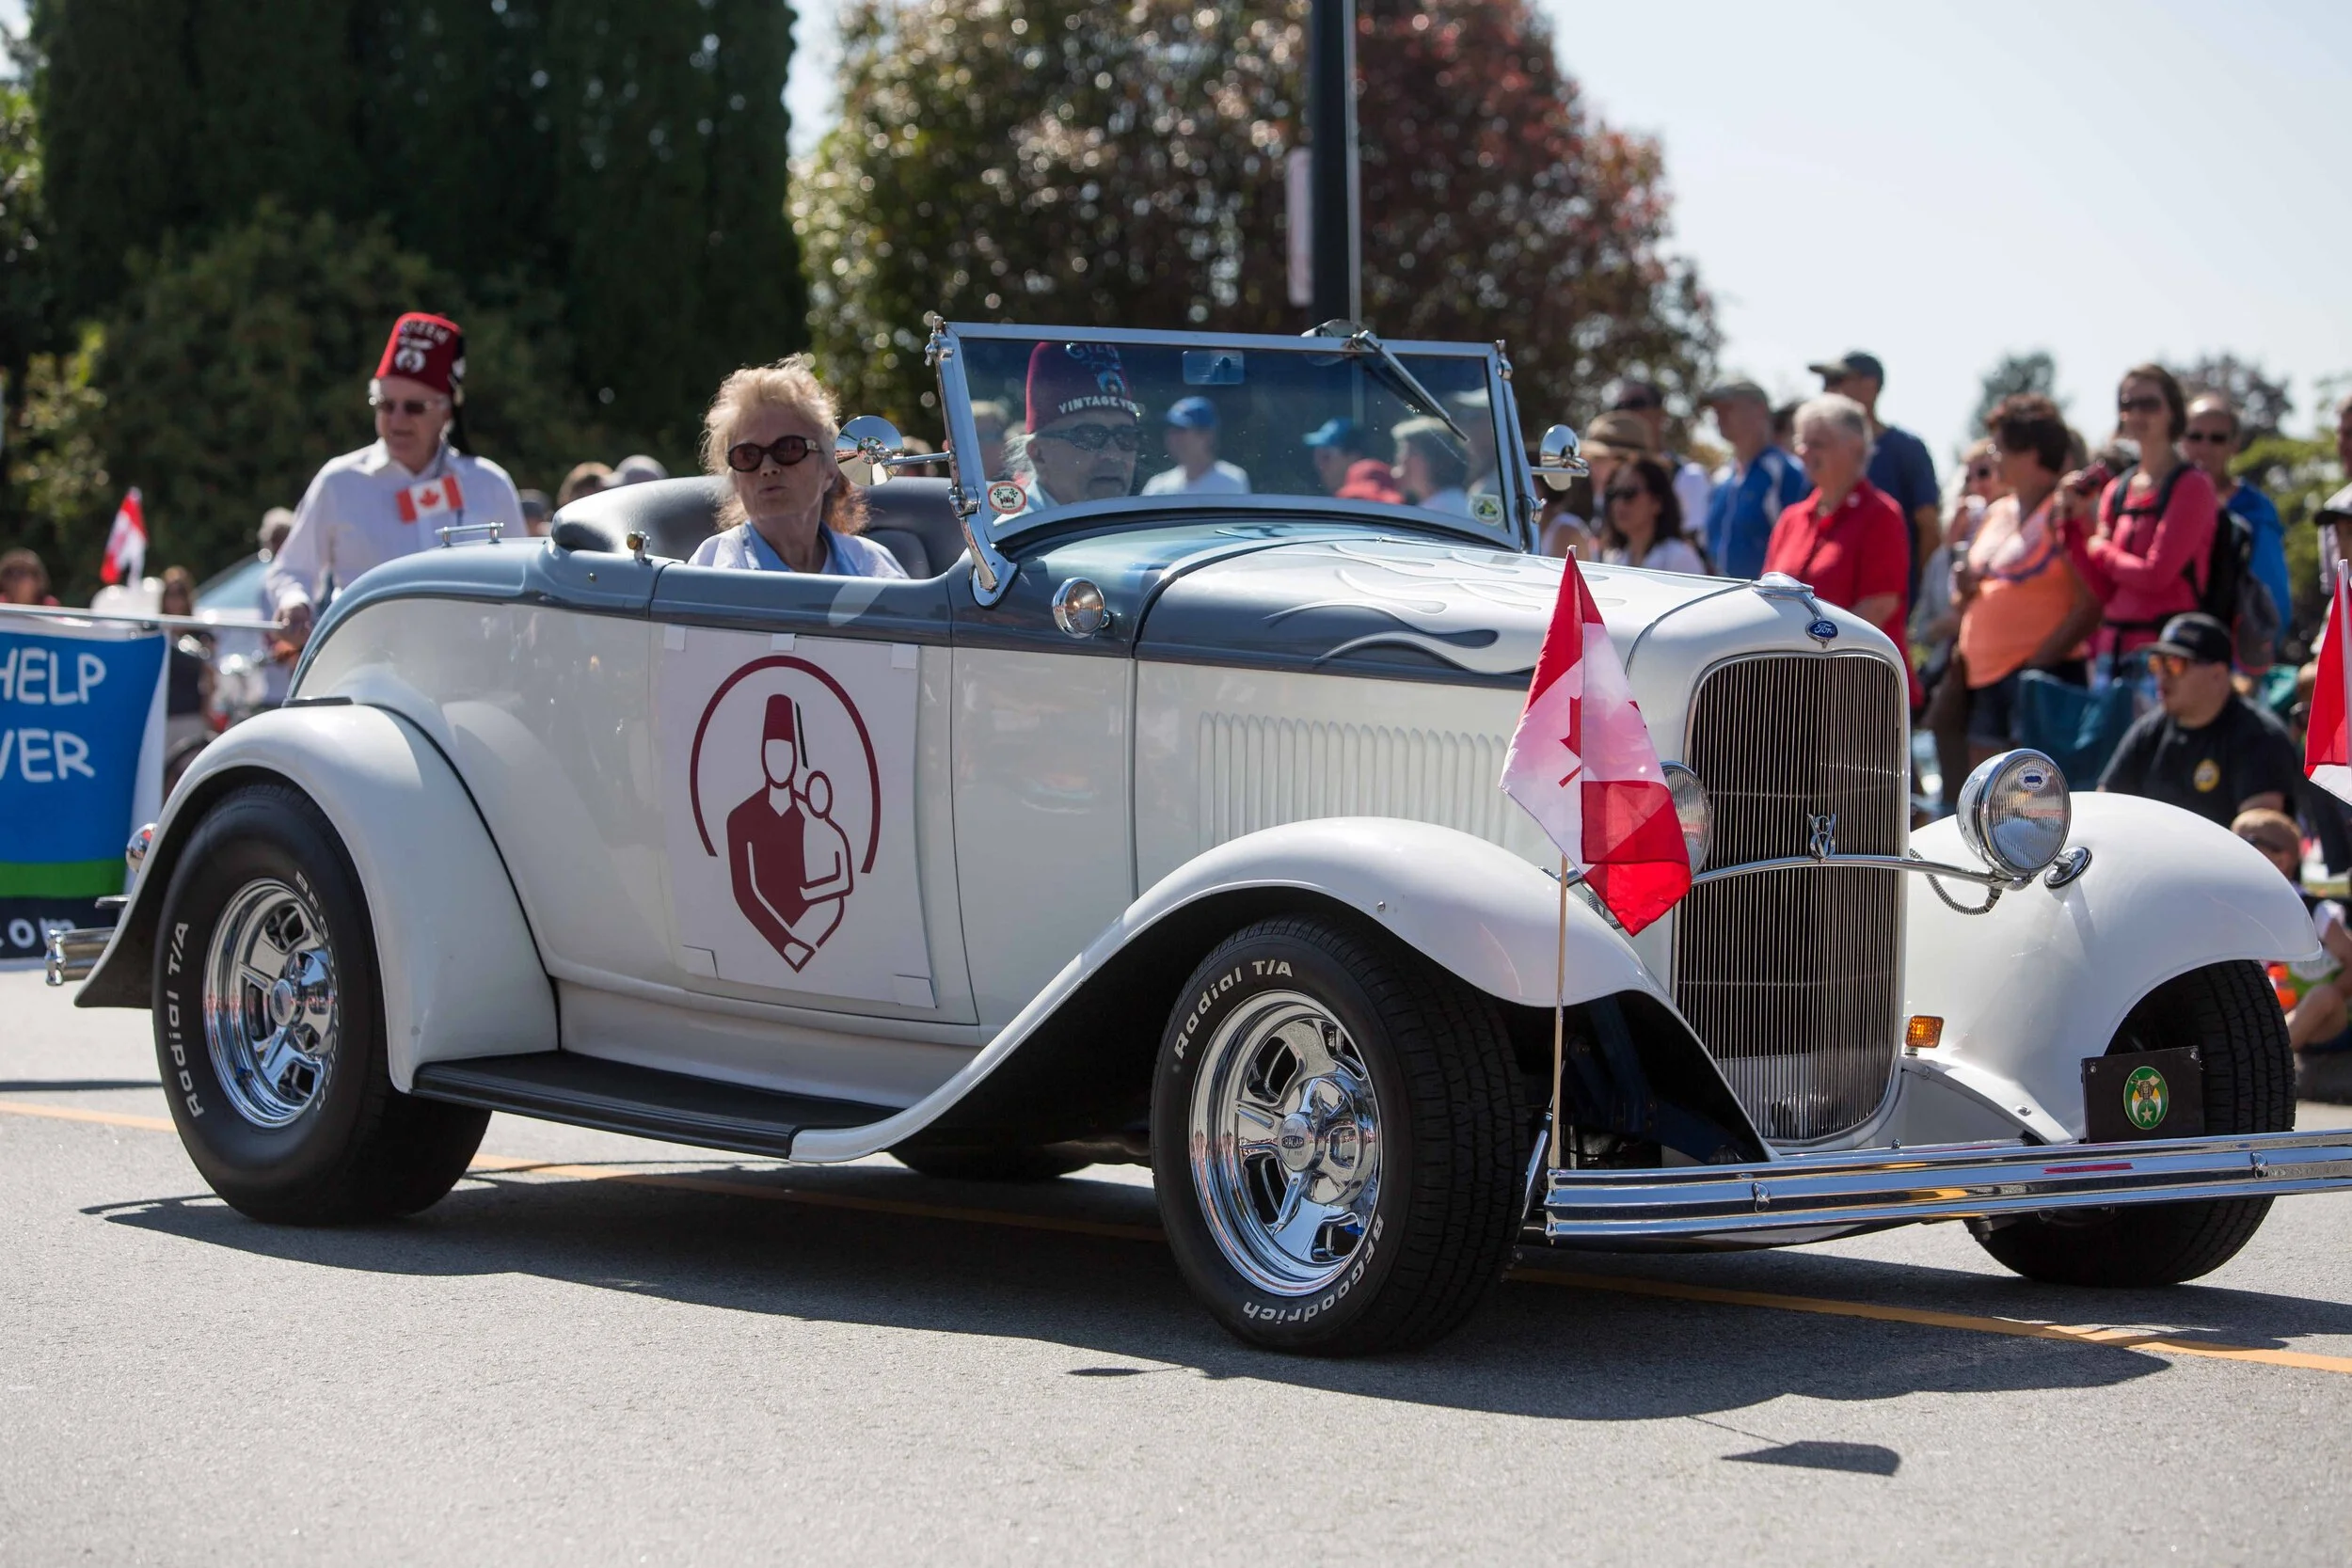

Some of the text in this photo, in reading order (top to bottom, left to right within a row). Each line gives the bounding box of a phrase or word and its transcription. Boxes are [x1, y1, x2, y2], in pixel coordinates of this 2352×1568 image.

[1058, 396, 1119, 414] VINTAGE
[0, 647, 106, 705] HELP
[167, 922, 204, 1117] Radial T/A
[1174, 959, 1293, 1059] Radial T/A
[1243, 1213, 1385, 1324] BFGoodrich
